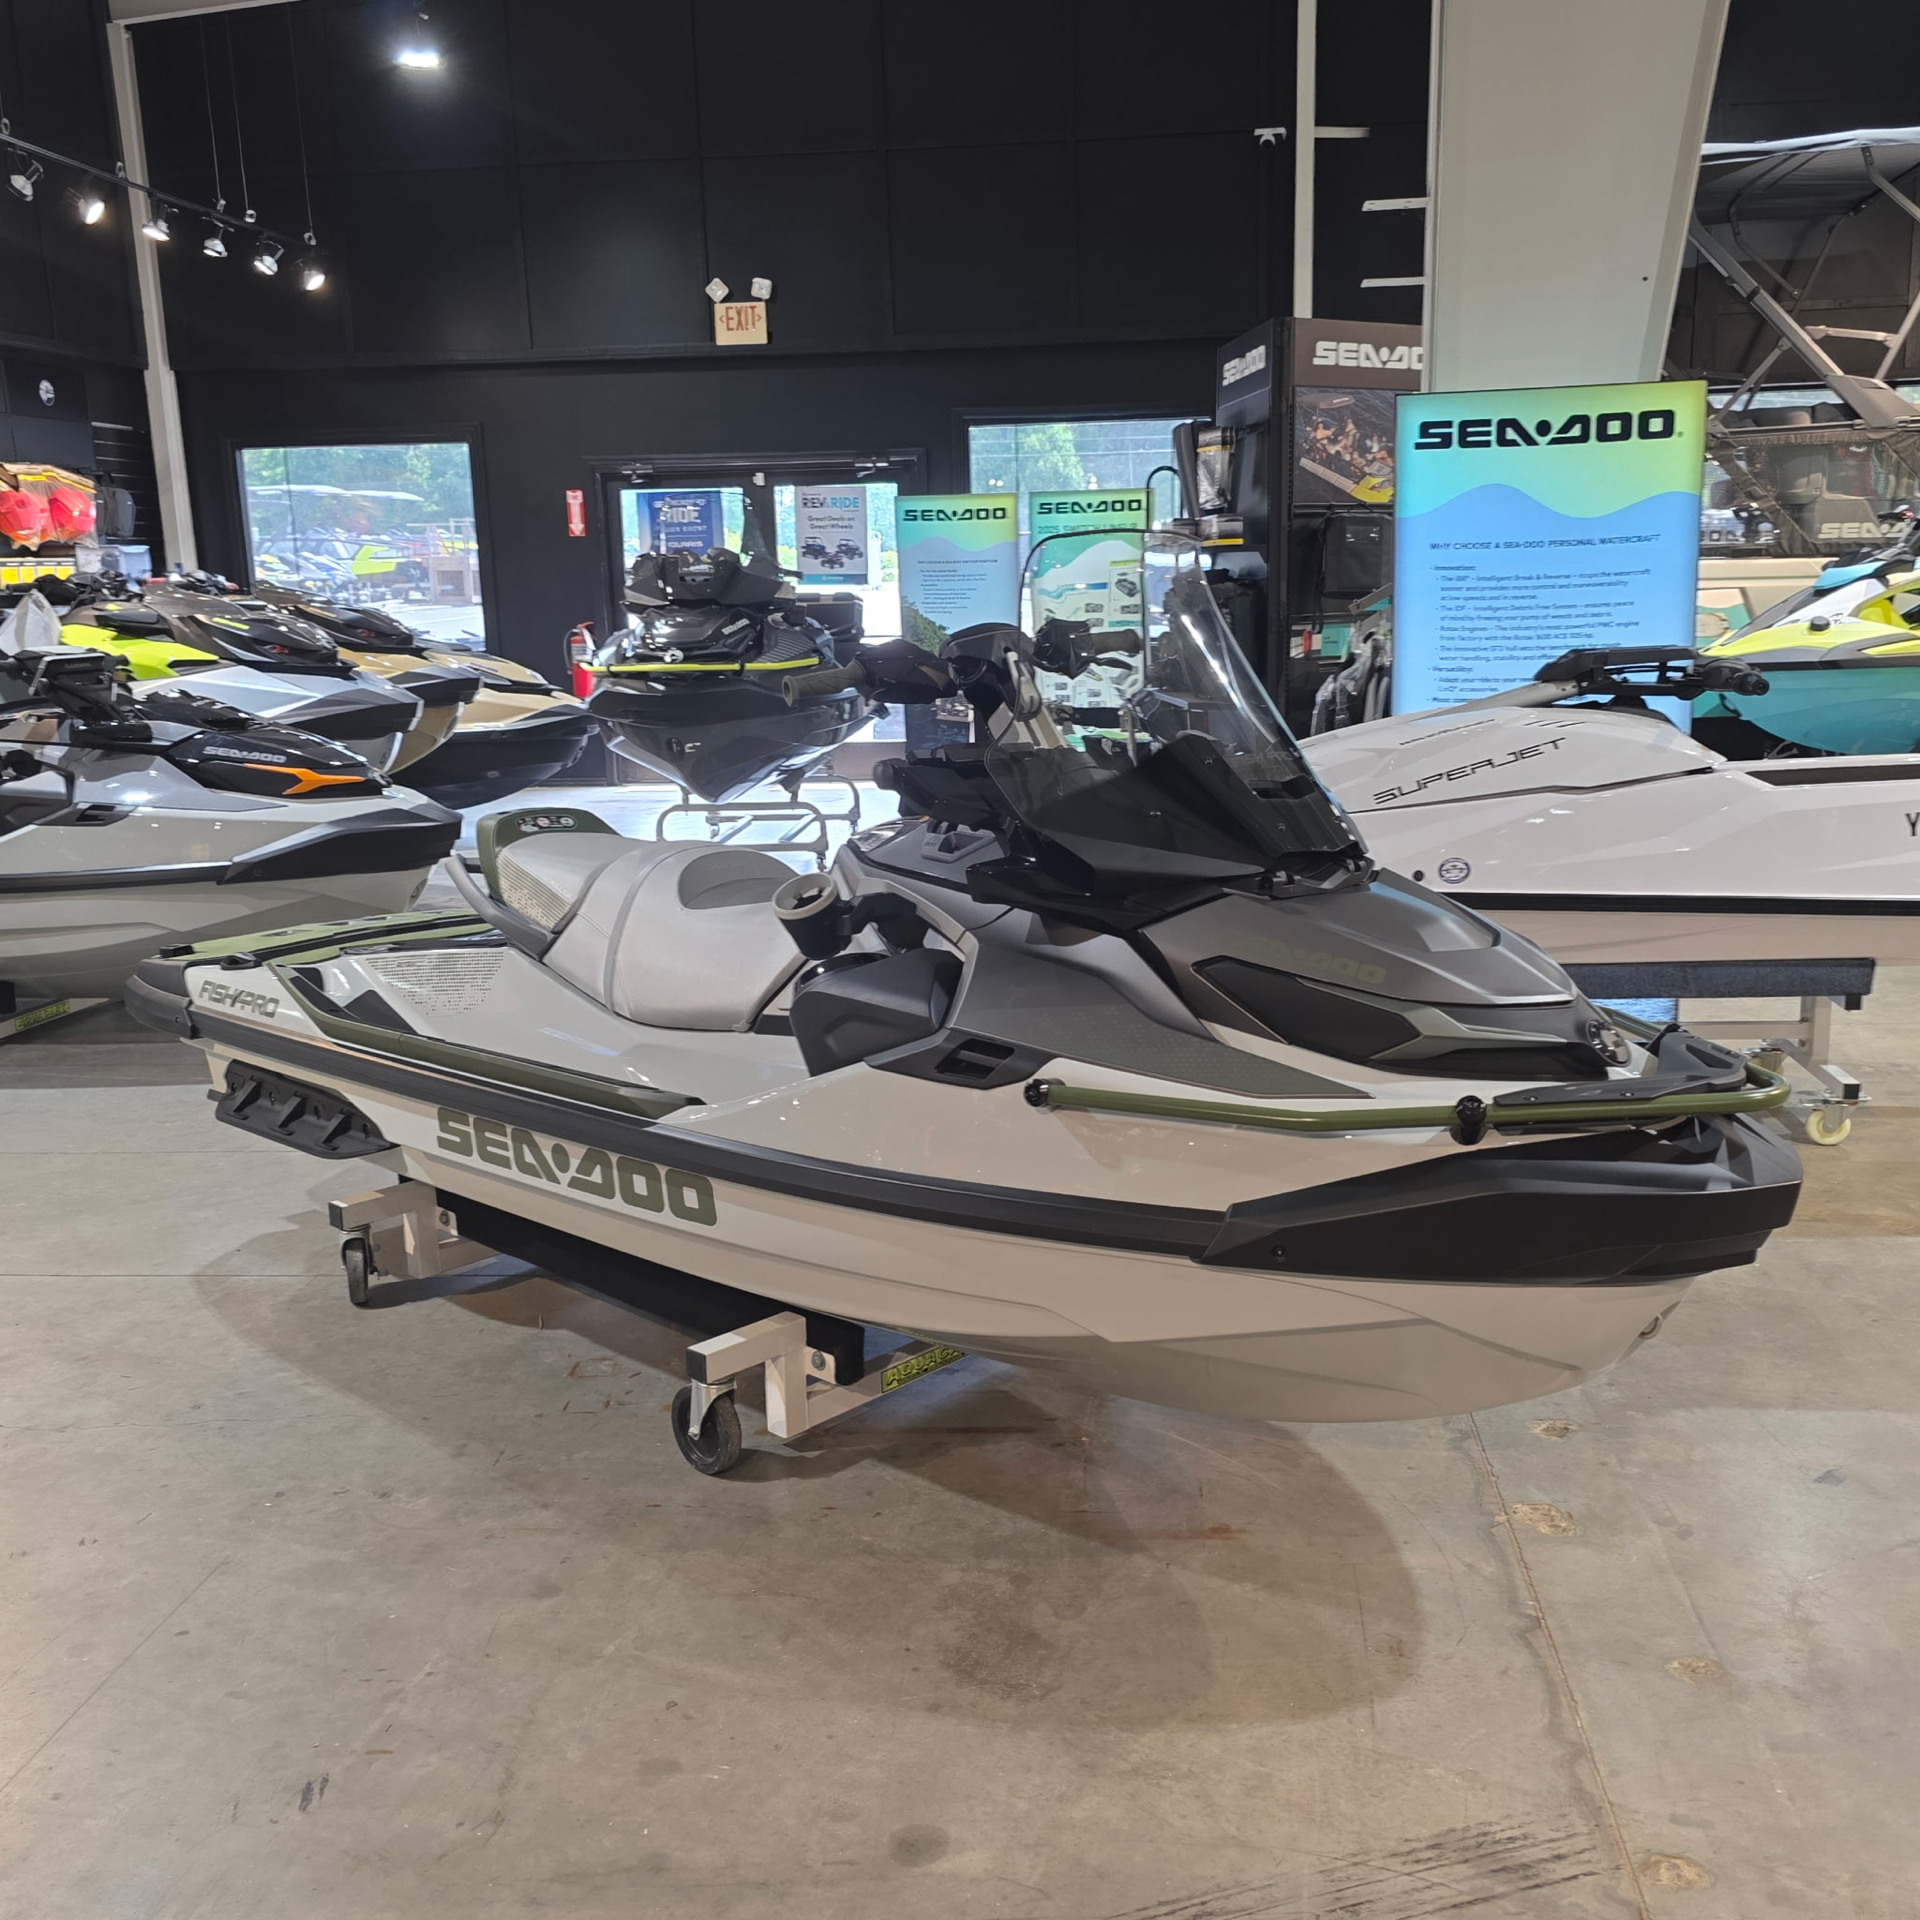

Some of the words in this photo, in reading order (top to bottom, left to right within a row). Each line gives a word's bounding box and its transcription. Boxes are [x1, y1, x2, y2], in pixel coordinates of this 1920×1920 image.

[725, 305, 757, 331] EXIT
[1453, 542, 1493, 550] CHOOSE
[1548, 539, 1597, 547] PERSONAL
[1598, 533, 1661, 545] WATERCRAFT
[1373, 737, 1566, 804] SUPERJET
